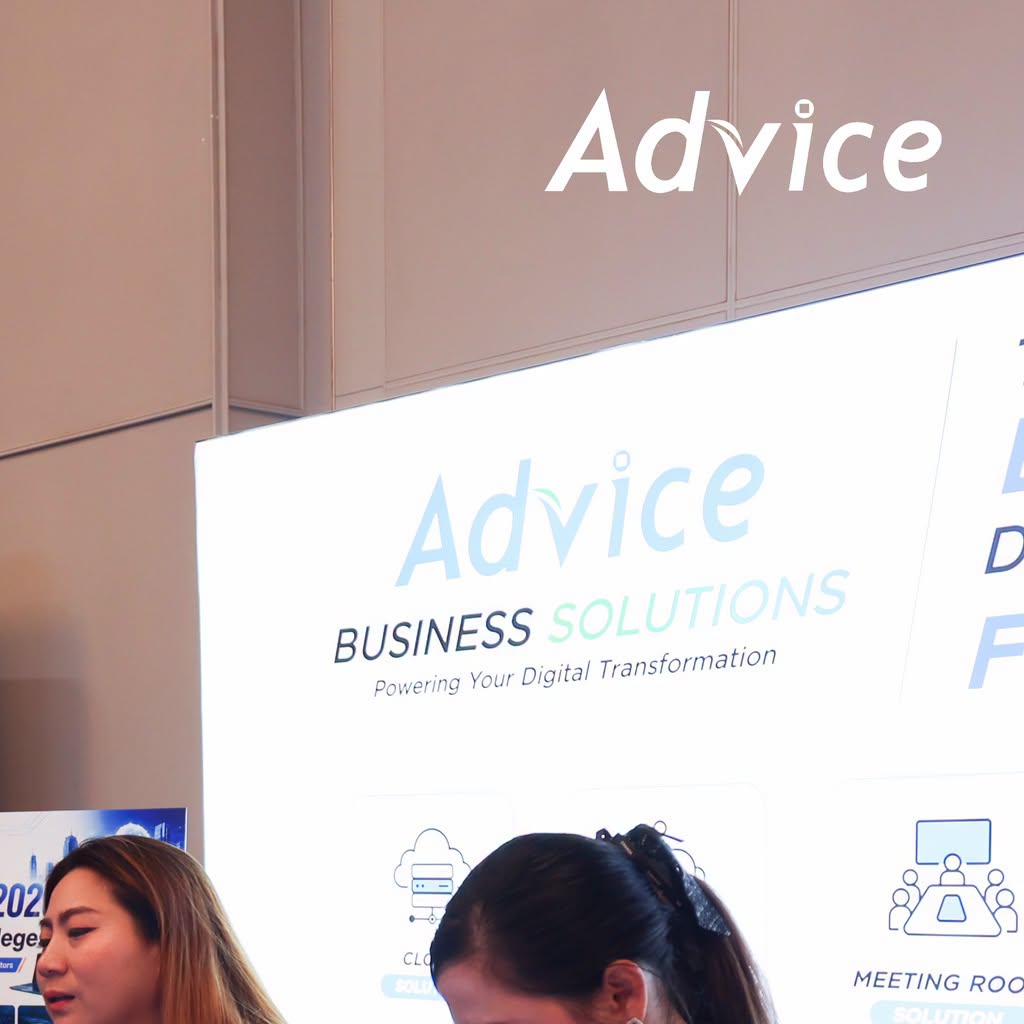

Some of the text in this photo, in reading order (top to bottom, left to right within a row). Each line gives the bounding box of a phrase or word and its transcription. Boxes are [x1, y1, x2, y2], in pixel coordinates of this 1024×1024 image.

[395, 449, 766, 587] Advice
[334, 569, 850, 663] BUSINESS SOLUTIONS
[374, 647, 777, 697] Powering Your Digital Transformation
[403, 952, 433, 967] CLO
[395, 977, 435, 994] SOLU
[853, 970, 1024, 994] MEETING ROO
